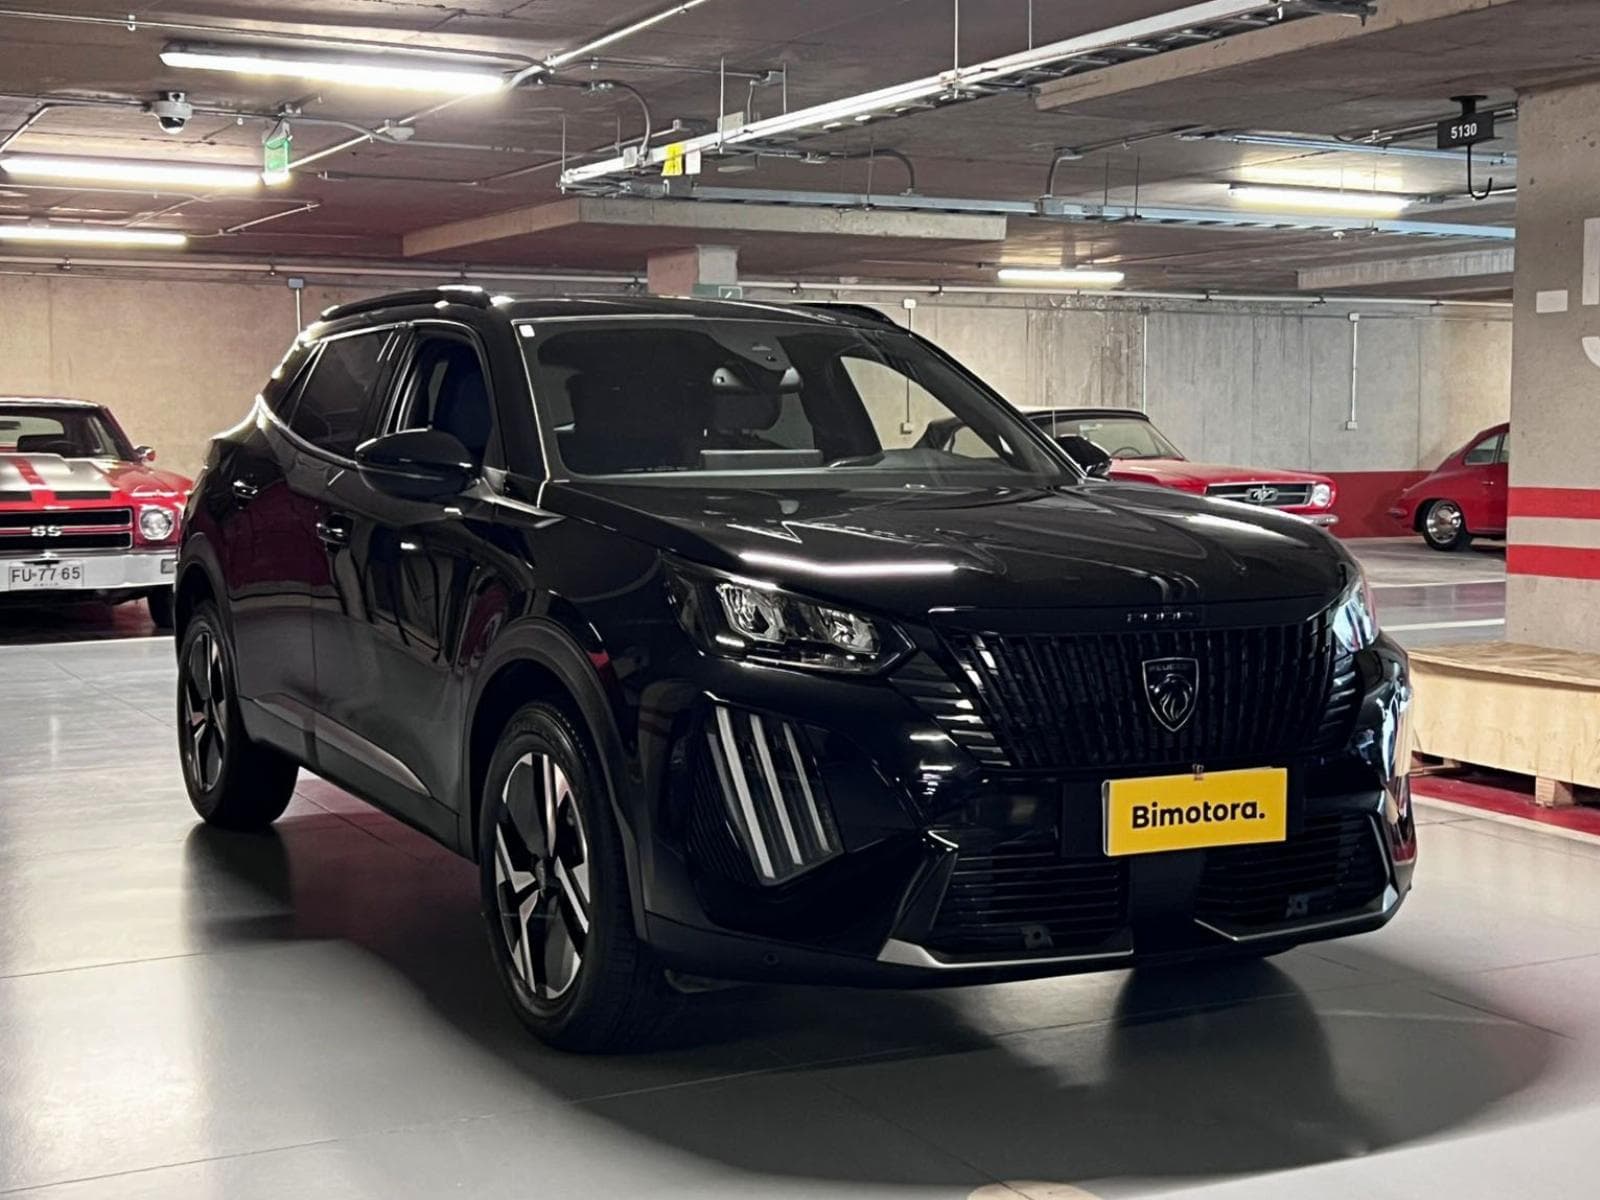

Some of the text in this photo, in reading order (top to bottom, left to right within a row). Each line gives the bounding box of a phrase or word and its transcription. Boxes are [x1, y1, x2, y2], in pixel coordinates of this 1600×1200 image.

[1450, 122, 1477, 139] 5130
[31, 525, 61, 537] SS
[1132, 801, 1265, 829] Bimotora.
